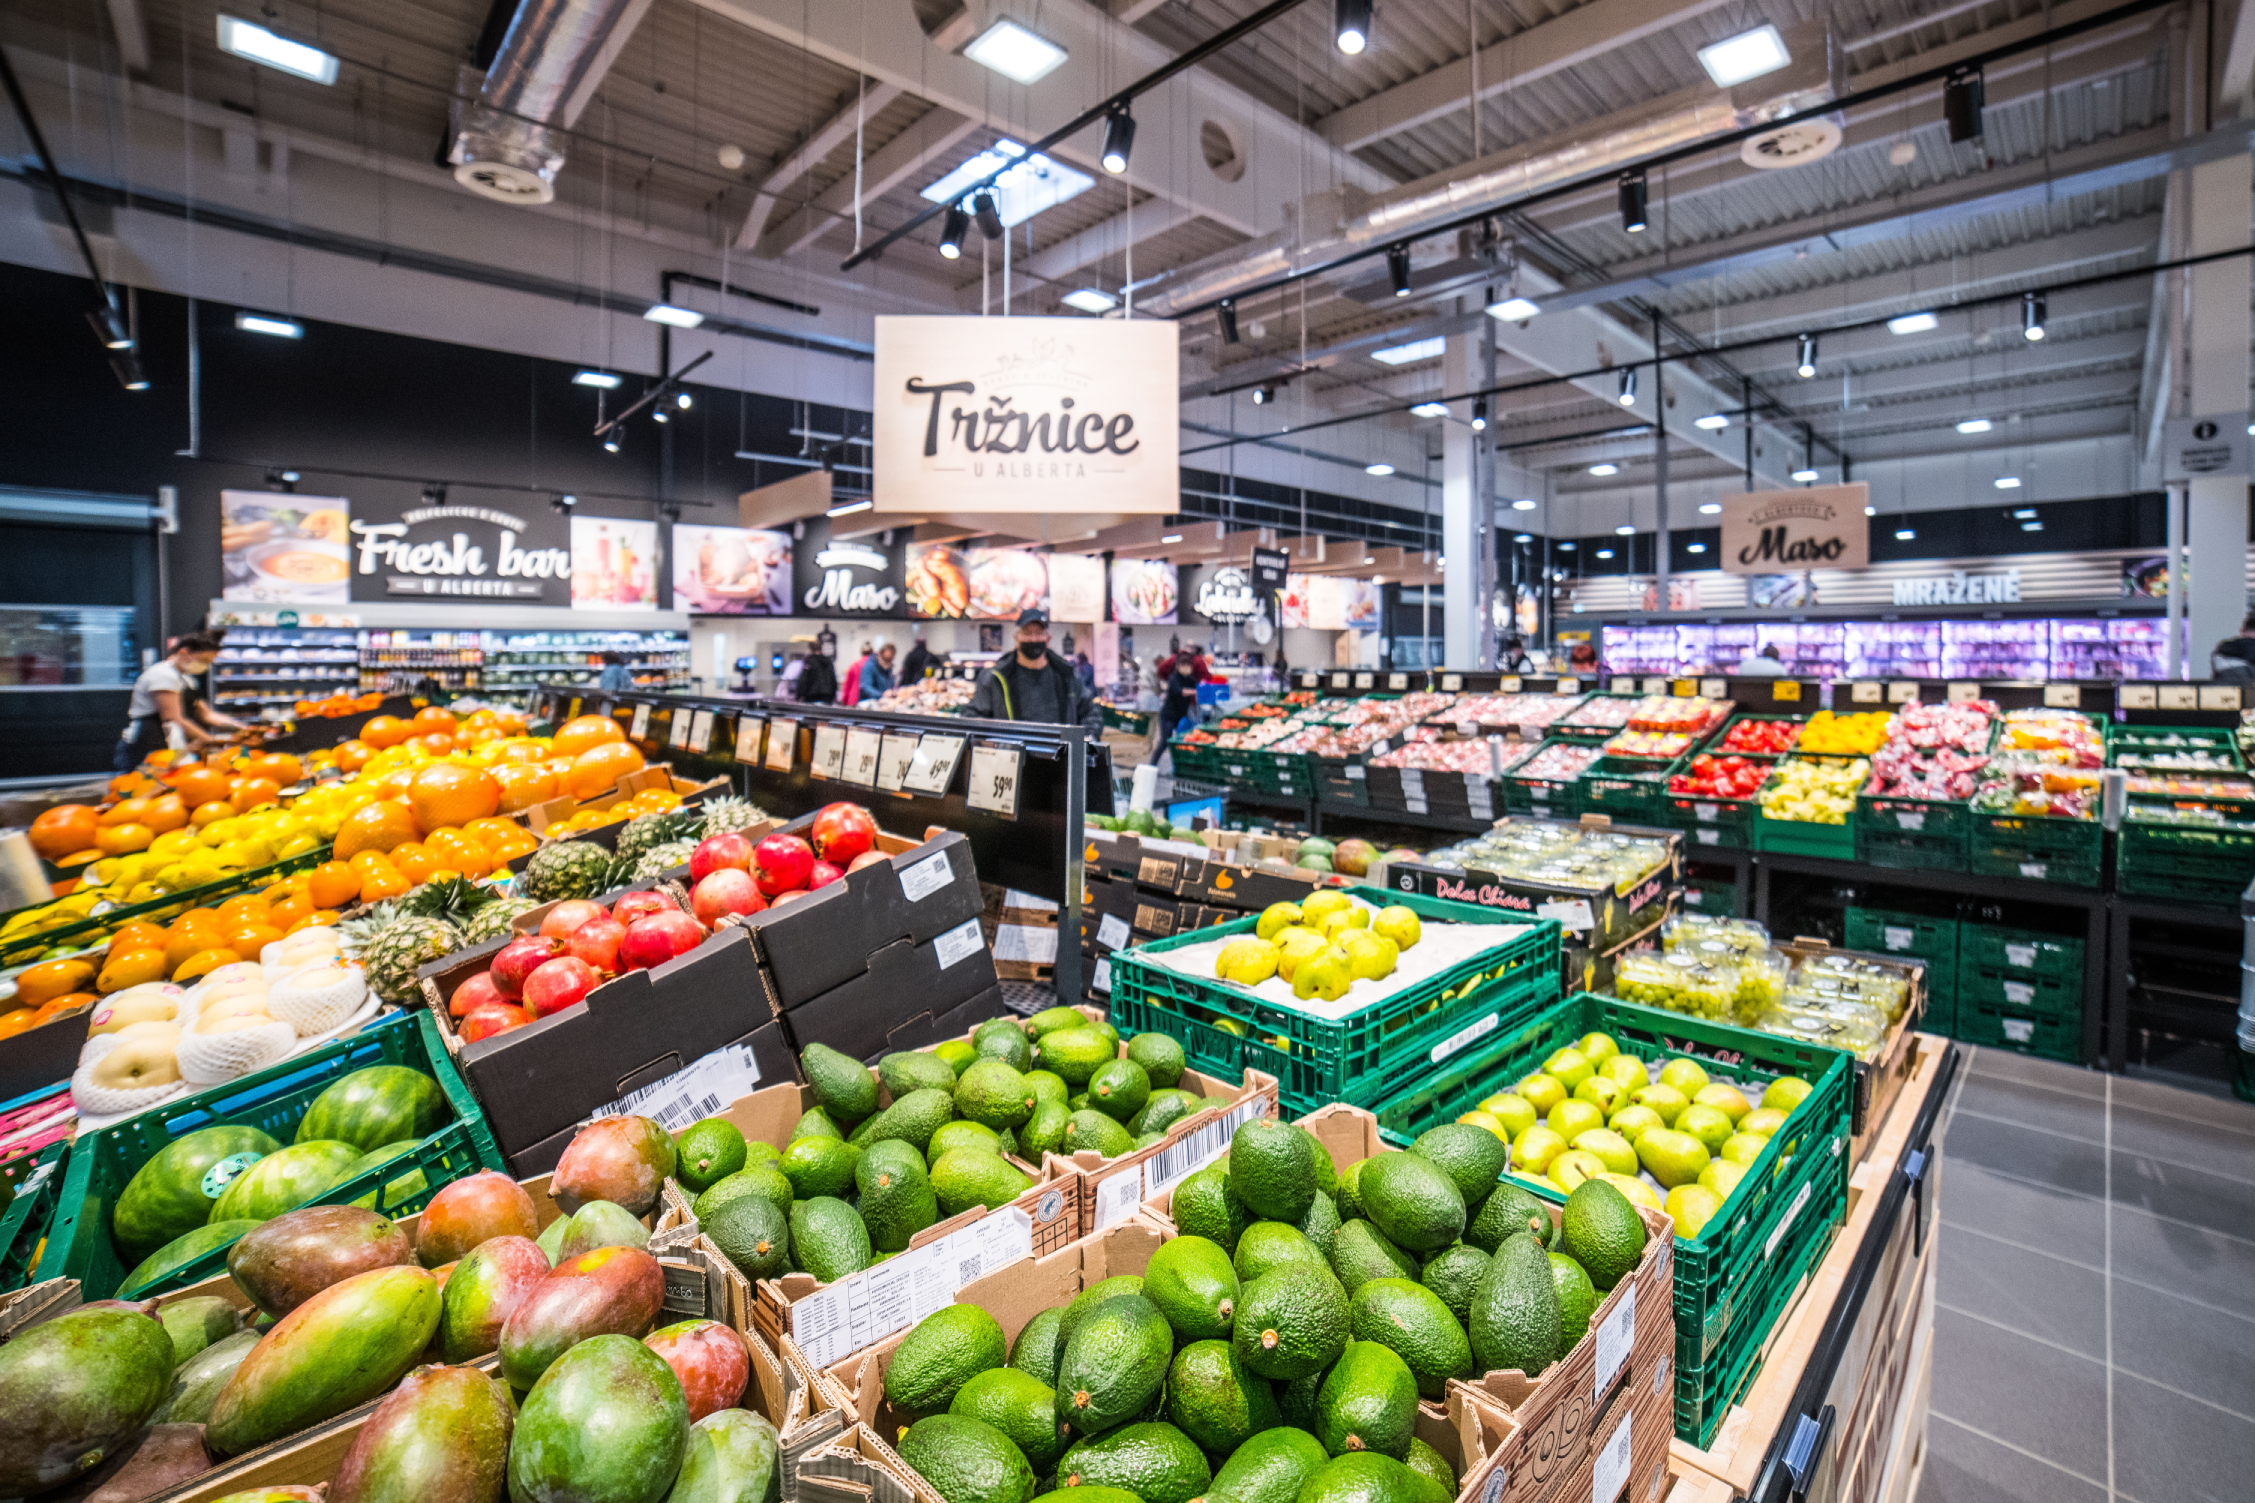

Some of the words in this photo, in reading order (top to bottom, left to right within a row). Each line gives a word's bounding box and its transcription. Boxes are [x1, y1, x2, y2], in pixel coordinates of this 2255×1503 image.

[906, 377, 1139, 457] Tržnice
[974, 463, 984, 477] U
[996, 463, 1085, 478] ALBERTA
[350, 519, 488, 575] Fresh
[497, 530, 571, 579] bar
[1738, 526, 1847, 565] Maso
[423, 578, 434, 593] U
[441, 579, 514, 595] ALBERTA
[804, 568, 899, 610] Maso
[1893, 567, 2021, 606] MRAŽENÉ
[1437, 877, 1476, 902] Dolce
[1478, 884, 1530, 910] Chiara
